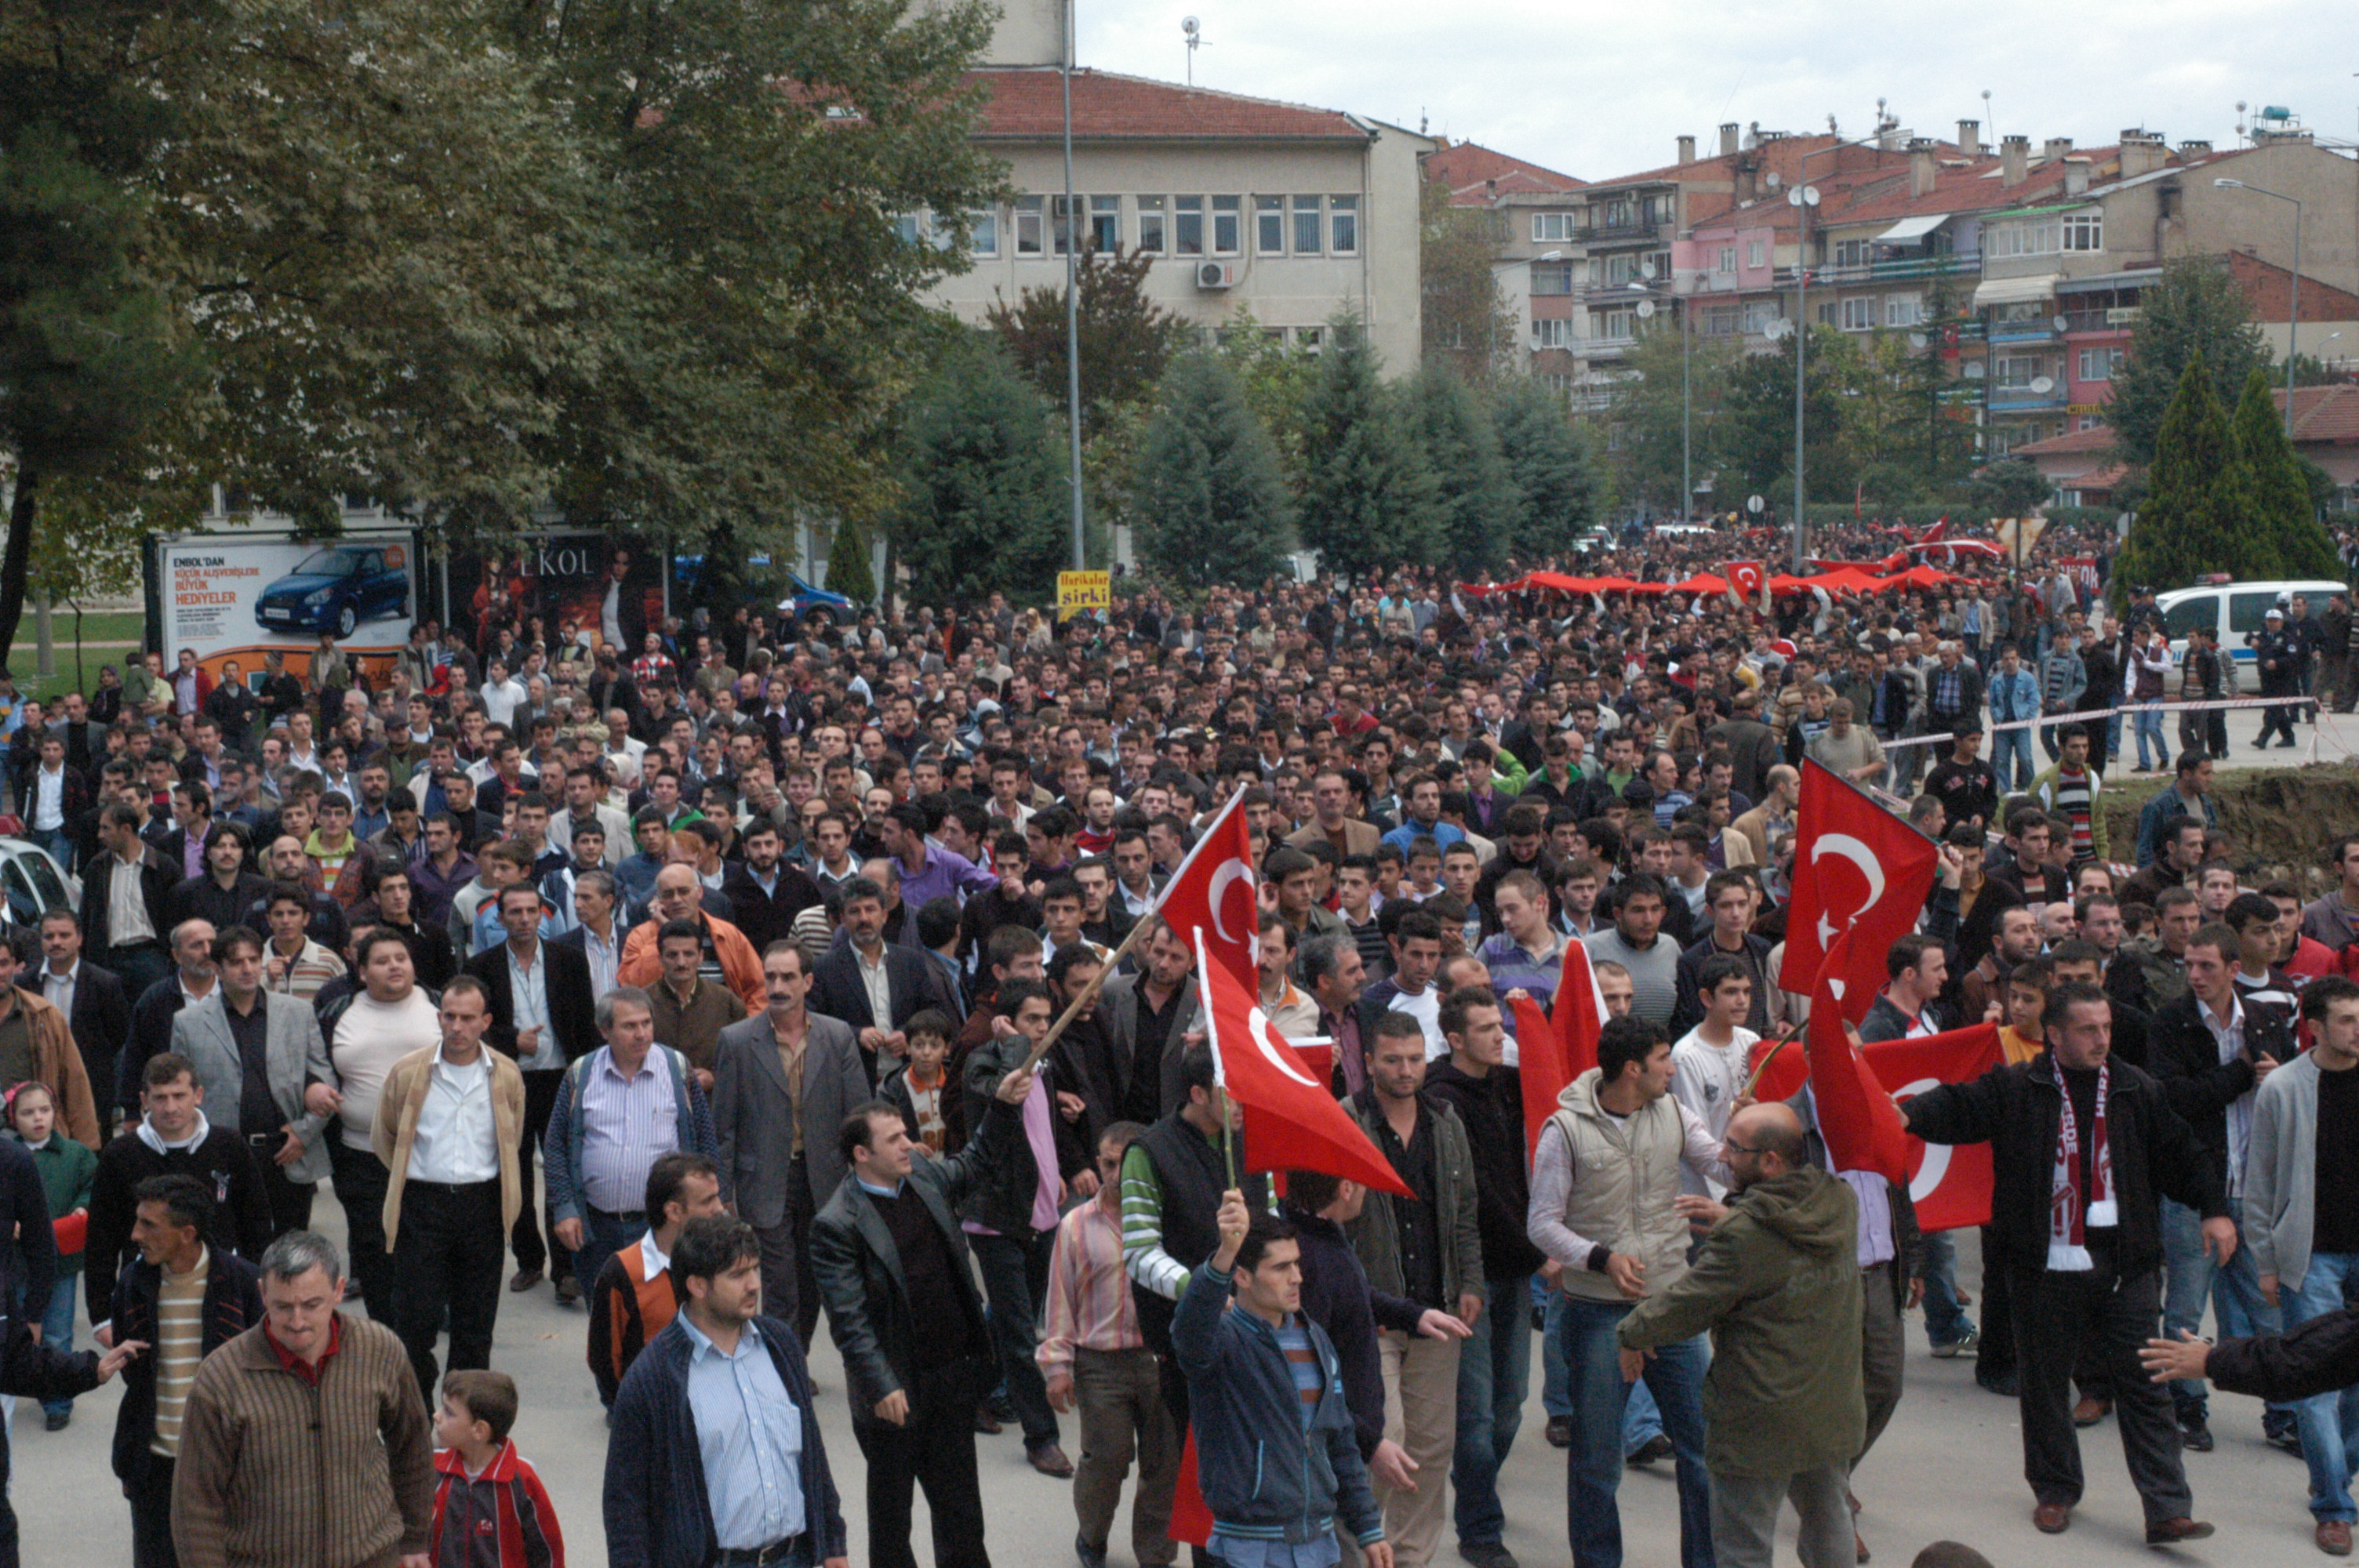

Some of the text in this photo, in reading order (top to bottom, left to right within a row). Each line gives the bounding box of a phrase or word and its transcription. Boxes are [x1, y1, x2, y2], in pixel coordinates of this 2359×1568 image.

[173, 557, 224, 567] ENBOL'DAN
[175, 568, 201, 578] KÜÇÜK
[176, 579, 208, 590] BÜYÜK
